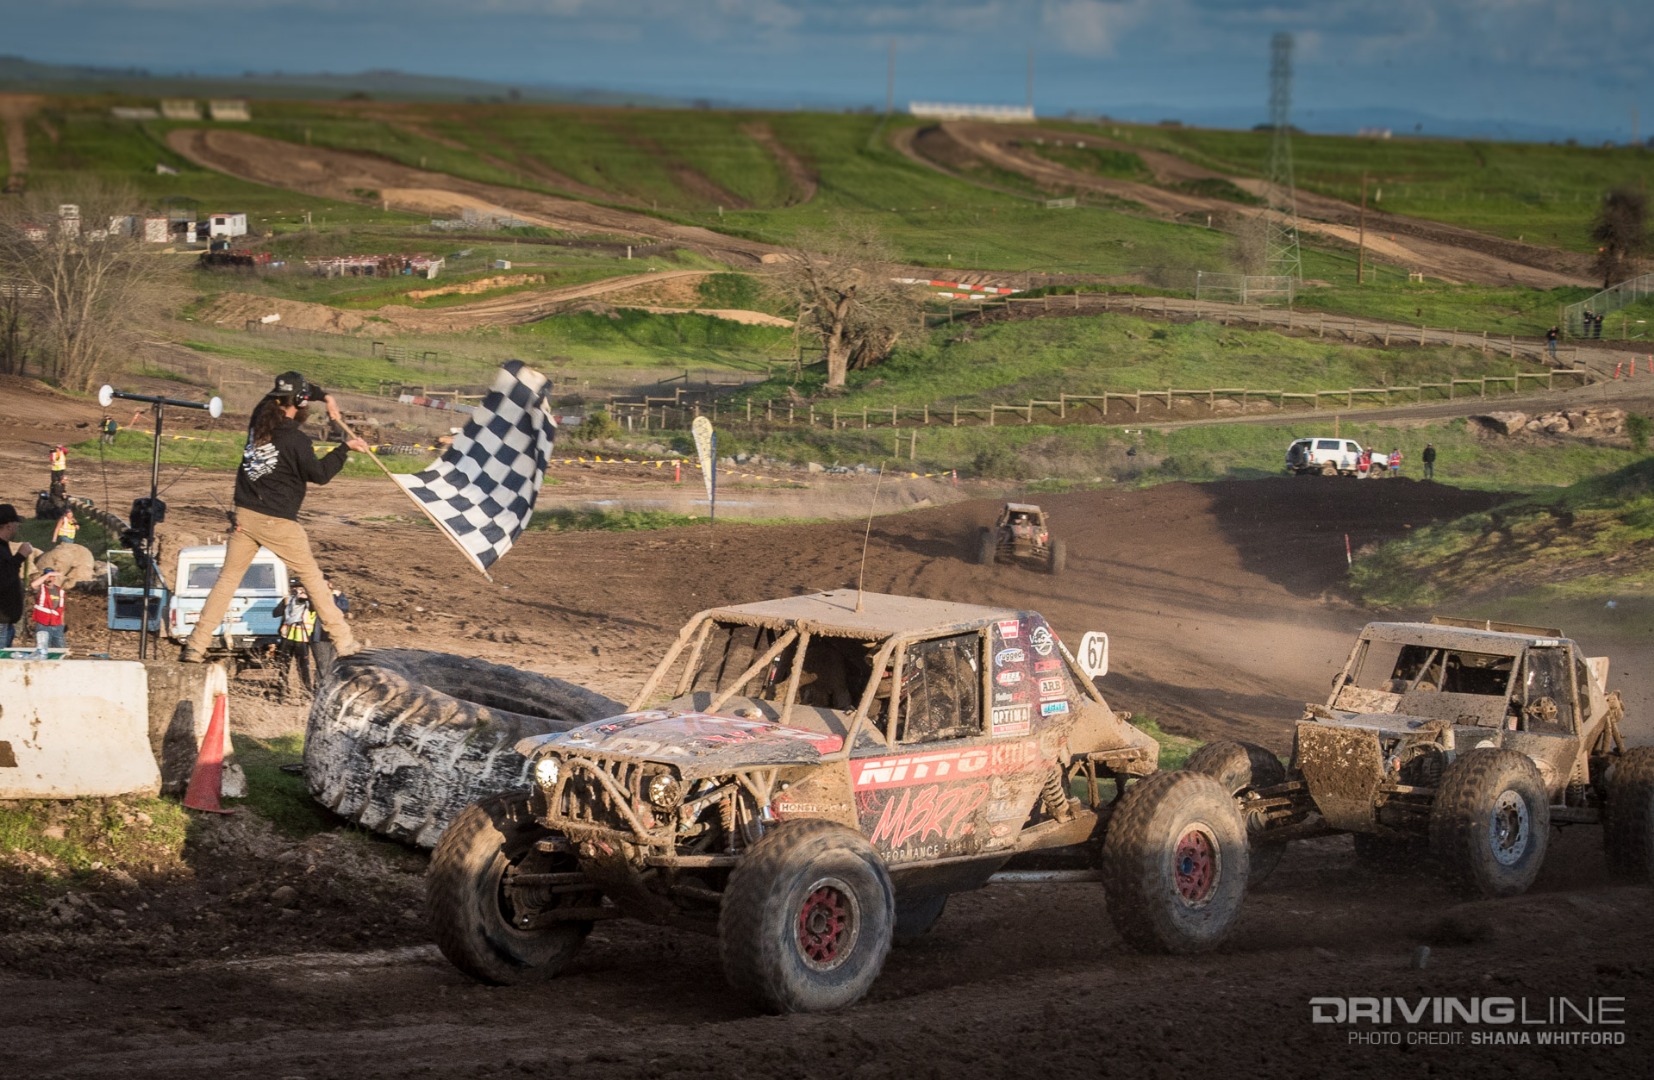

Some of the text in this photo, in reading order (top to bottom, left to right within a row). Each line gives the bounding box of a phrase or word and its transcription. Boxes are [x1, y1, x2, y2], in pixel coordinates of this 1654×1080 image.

[1088, 636, 1105, 670] 67
[1042, 680, 1061, 692] ARB
[993, 707, 1028, 726] OPTIMA
[857, 750, 988, 785] NITTO
[870, 781, 989, 849] MBRP
